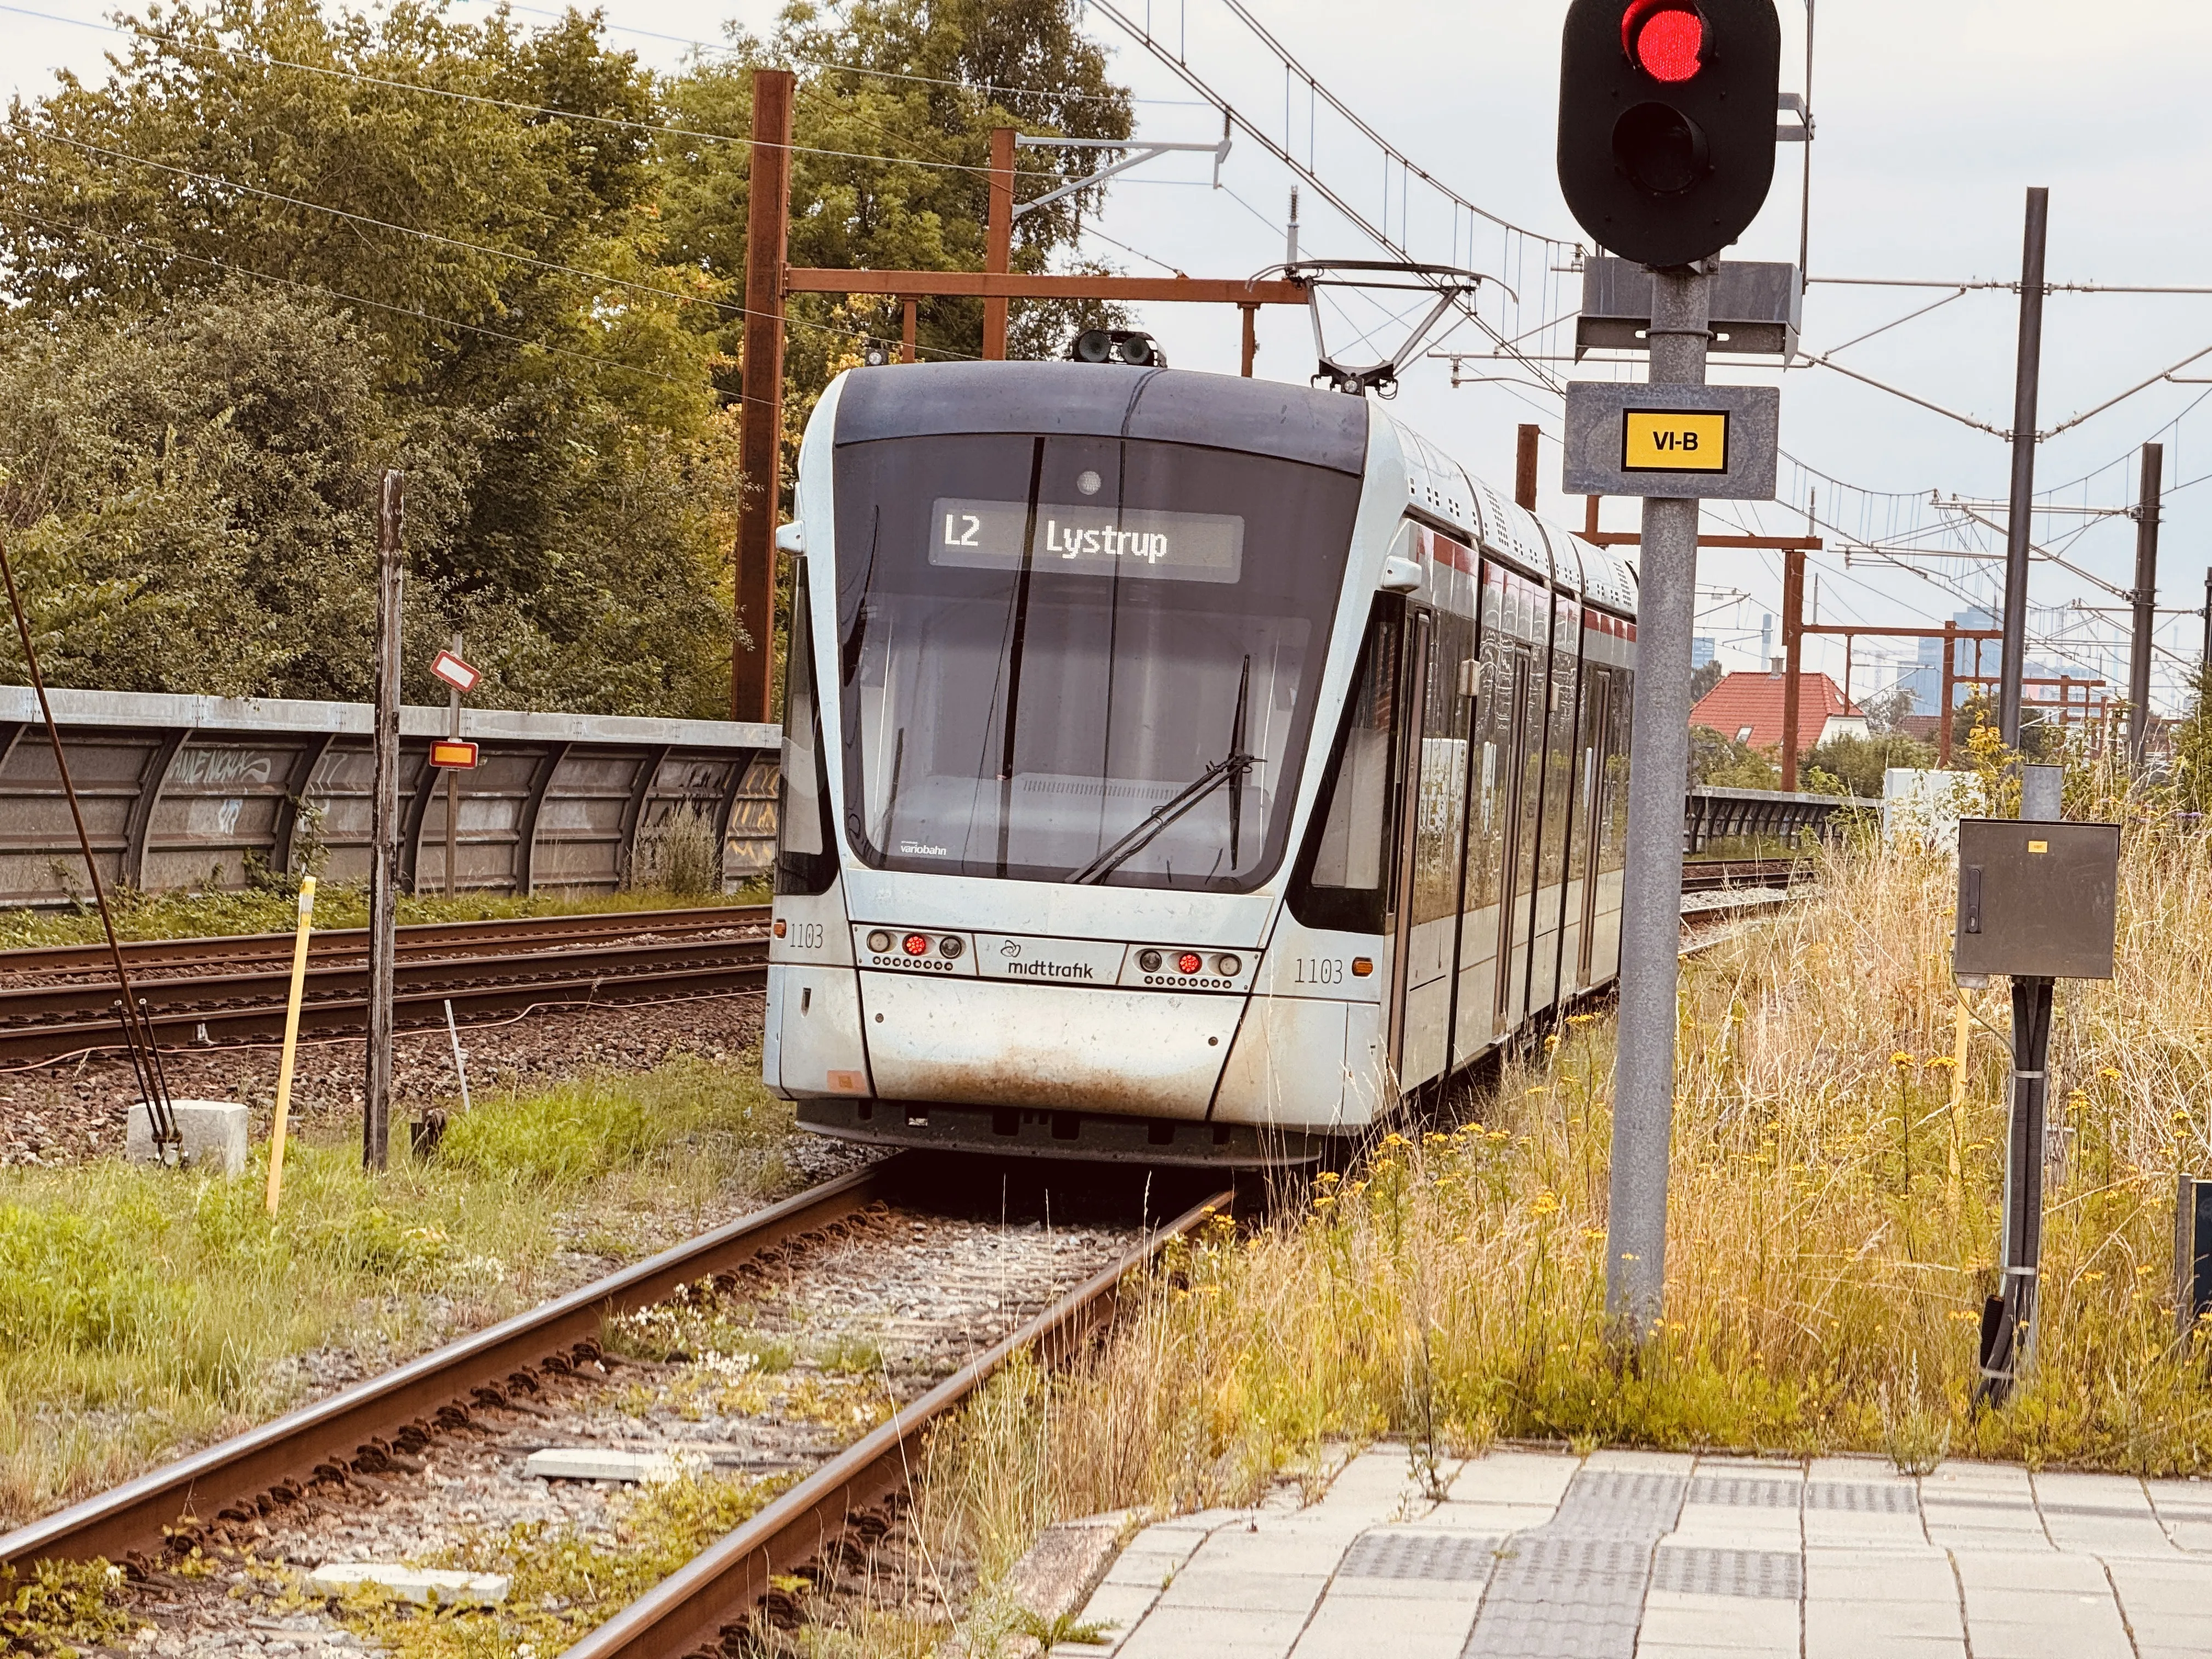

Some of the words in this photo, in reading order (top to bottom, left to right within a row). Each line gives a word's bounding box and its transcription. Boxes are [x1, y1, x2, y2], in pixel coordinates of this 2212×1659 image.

[1652, 431, 1699, 451] VI-B
[944, 514, 980, 547] L2
[1046, 520, 1168, 564] Lystrup
[900, 844, 947, 856] variobahn
[789, 923, 823, 950] 1103
[1008, 960, 1093, 979] midttrafik
[1294, 958, 1343, 985] 1103
